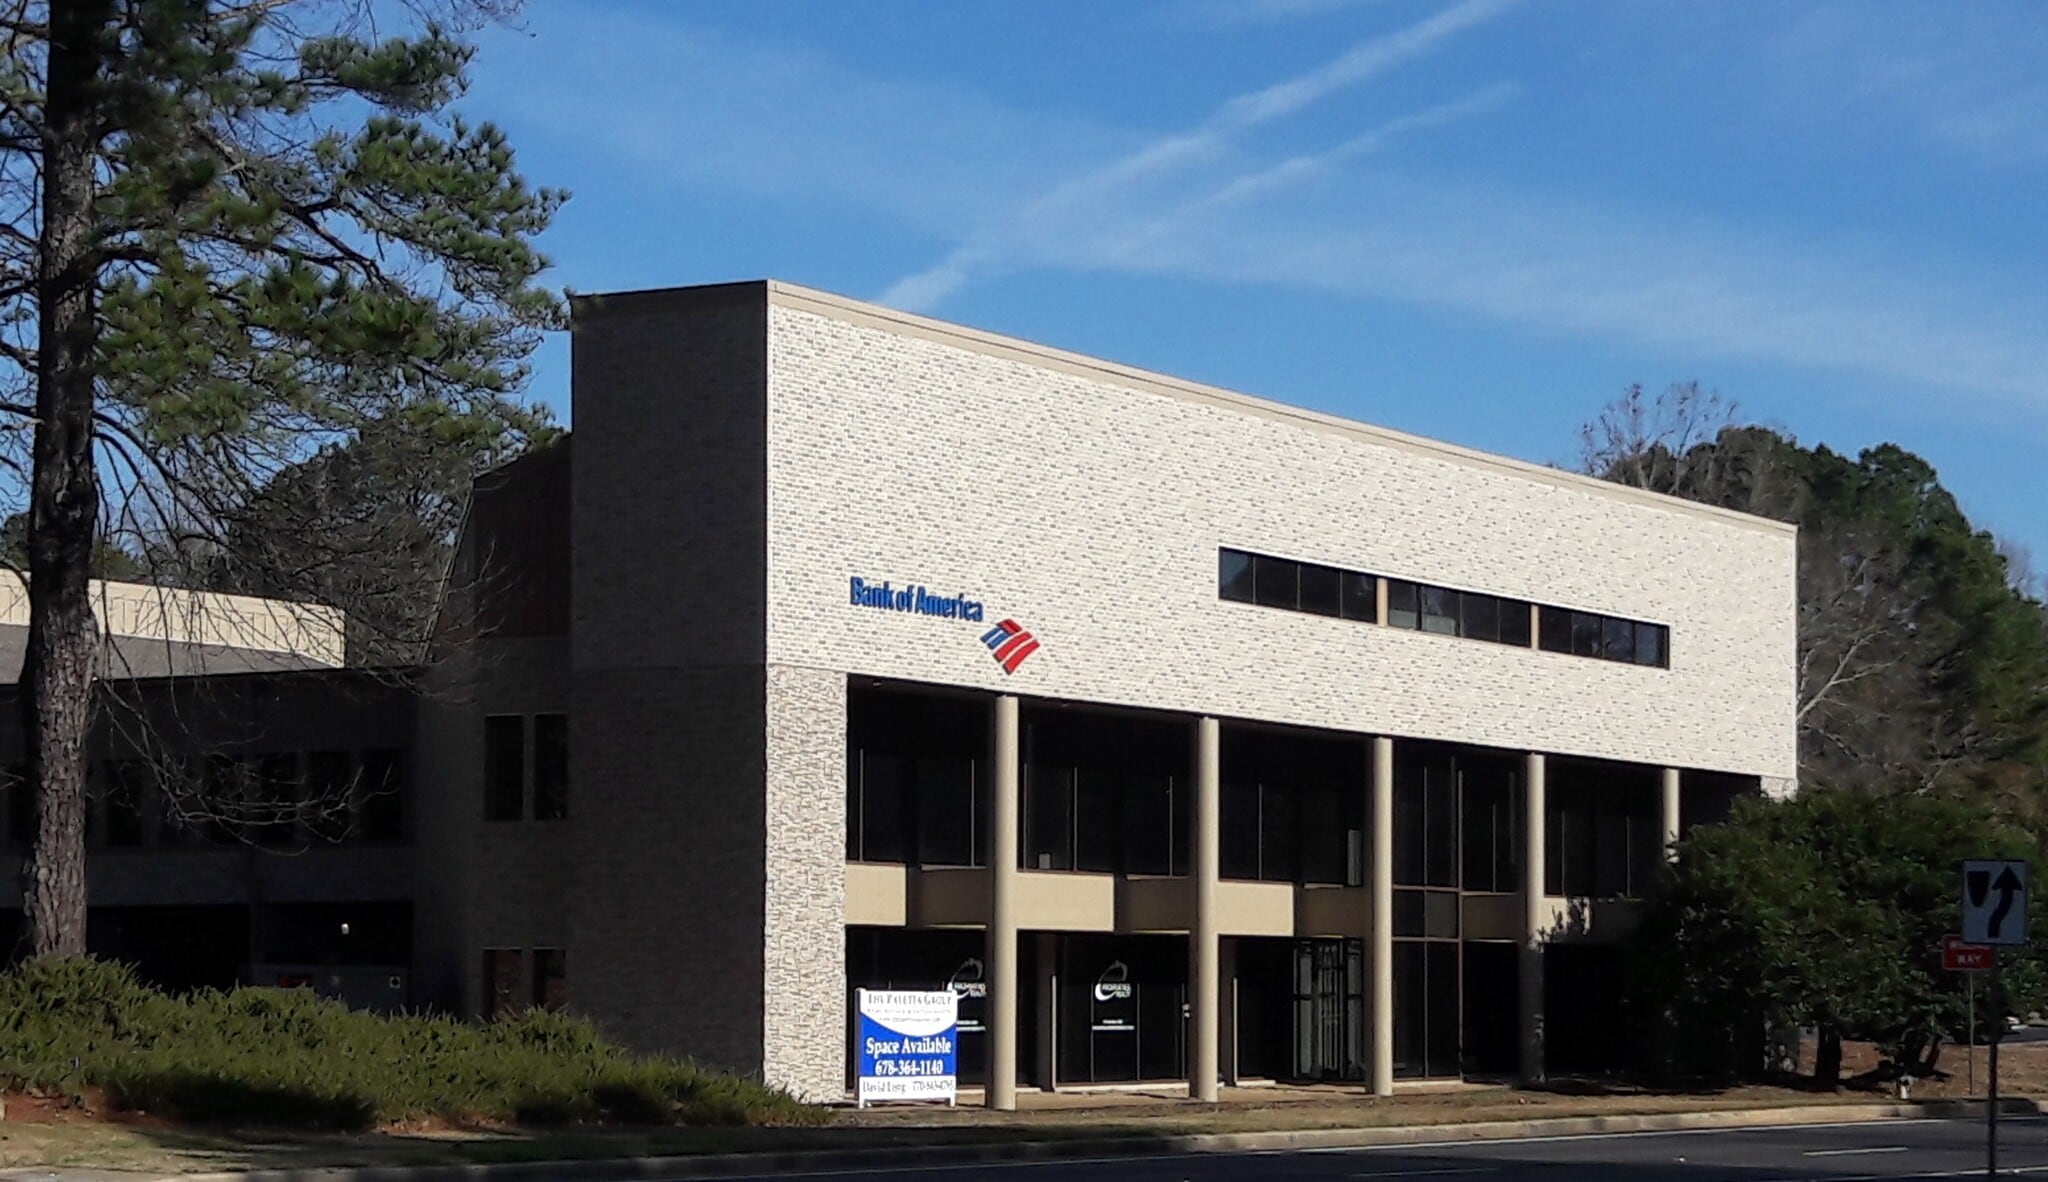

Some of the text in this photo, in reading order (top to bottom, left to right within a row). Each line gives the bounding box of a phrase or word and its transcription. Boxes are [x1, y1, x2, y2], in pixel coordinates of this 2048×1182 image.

[850, 576, 983, 622] Bank of America
[866, 1036, 952, 1060] Space Available
[875, 1059, 944, 1076] 678-364-1140
